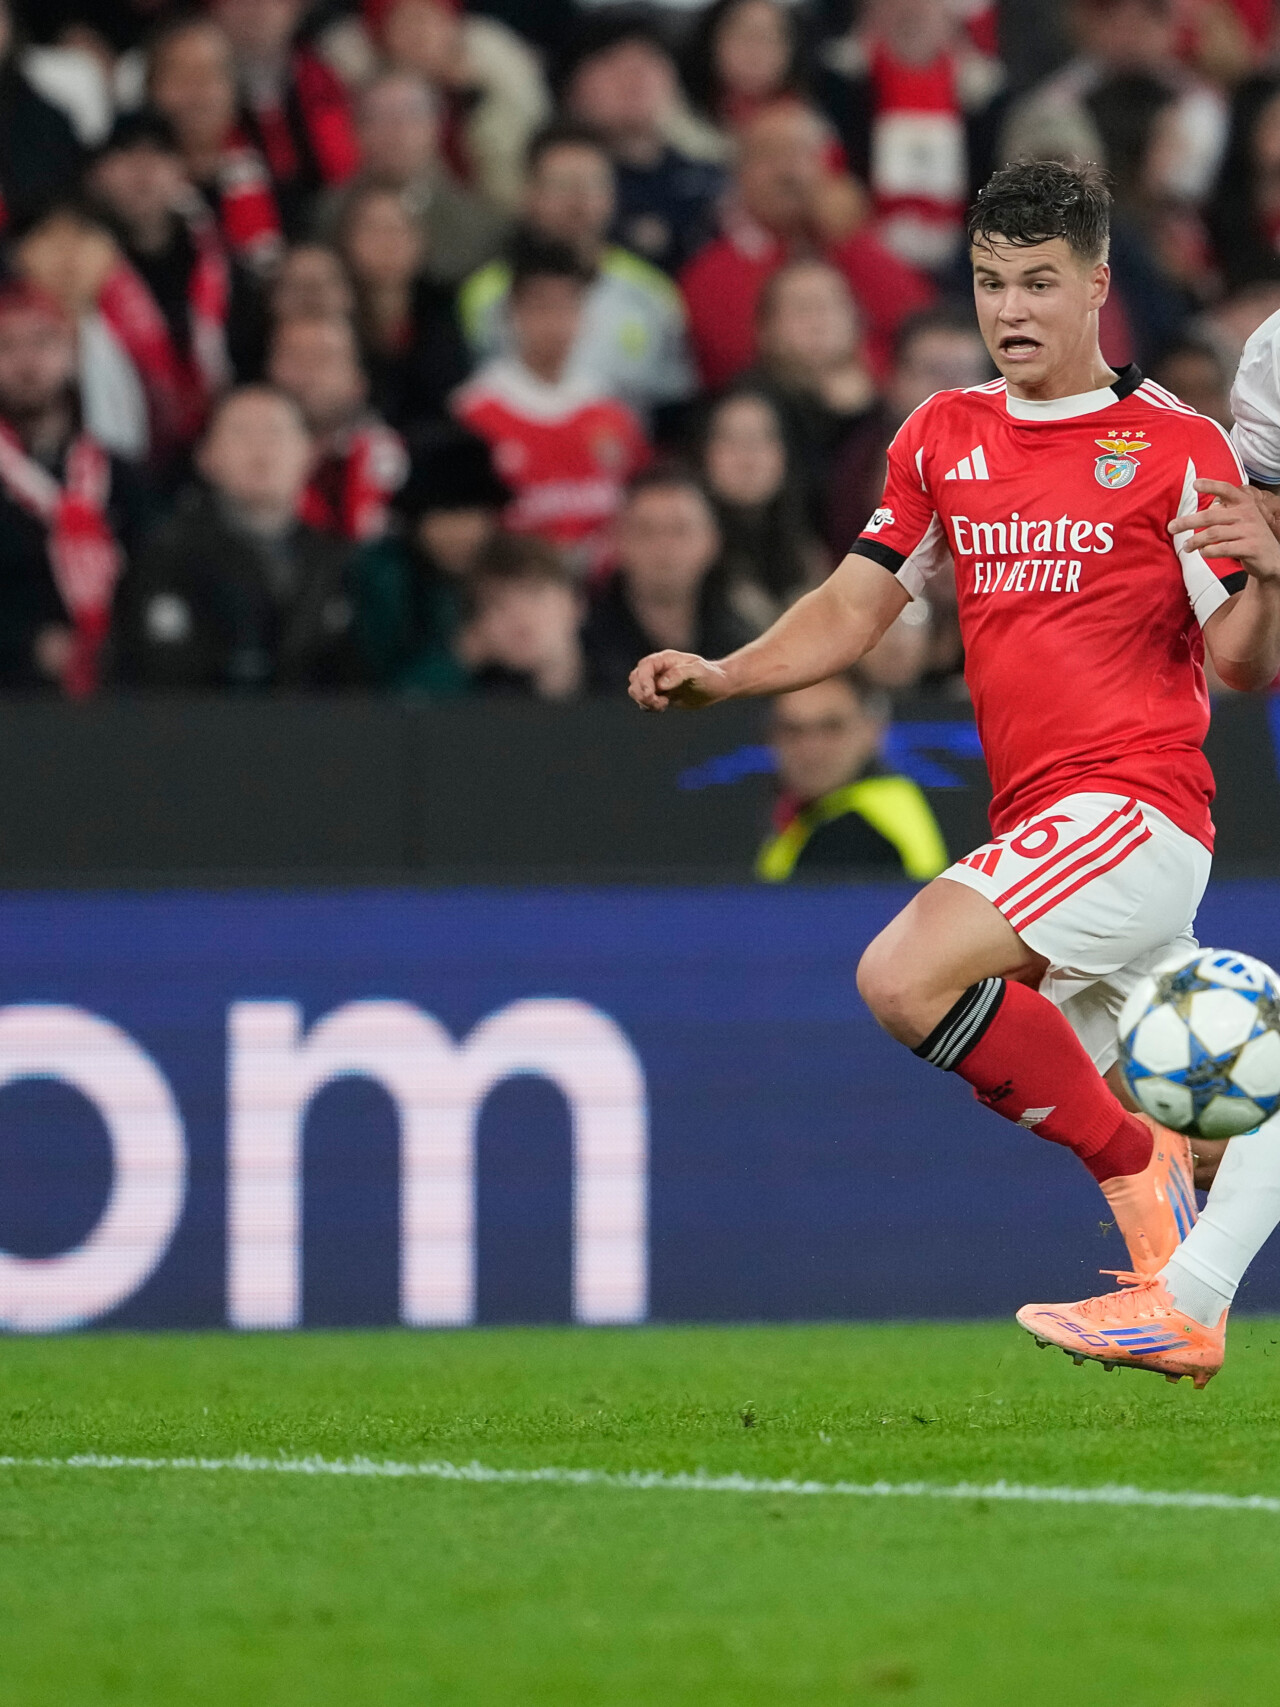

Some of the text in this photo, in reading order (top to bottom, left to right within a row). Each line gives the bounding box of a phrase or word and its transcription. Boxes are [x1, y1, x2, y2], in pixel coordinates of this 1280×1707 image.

[951, 512, 1114, 555] Emirates
[974, 559, 1082, 594] FLY BETTER
[0, 997, 648, 1334] om
[1035, 1312, 1109, 1347] F50
